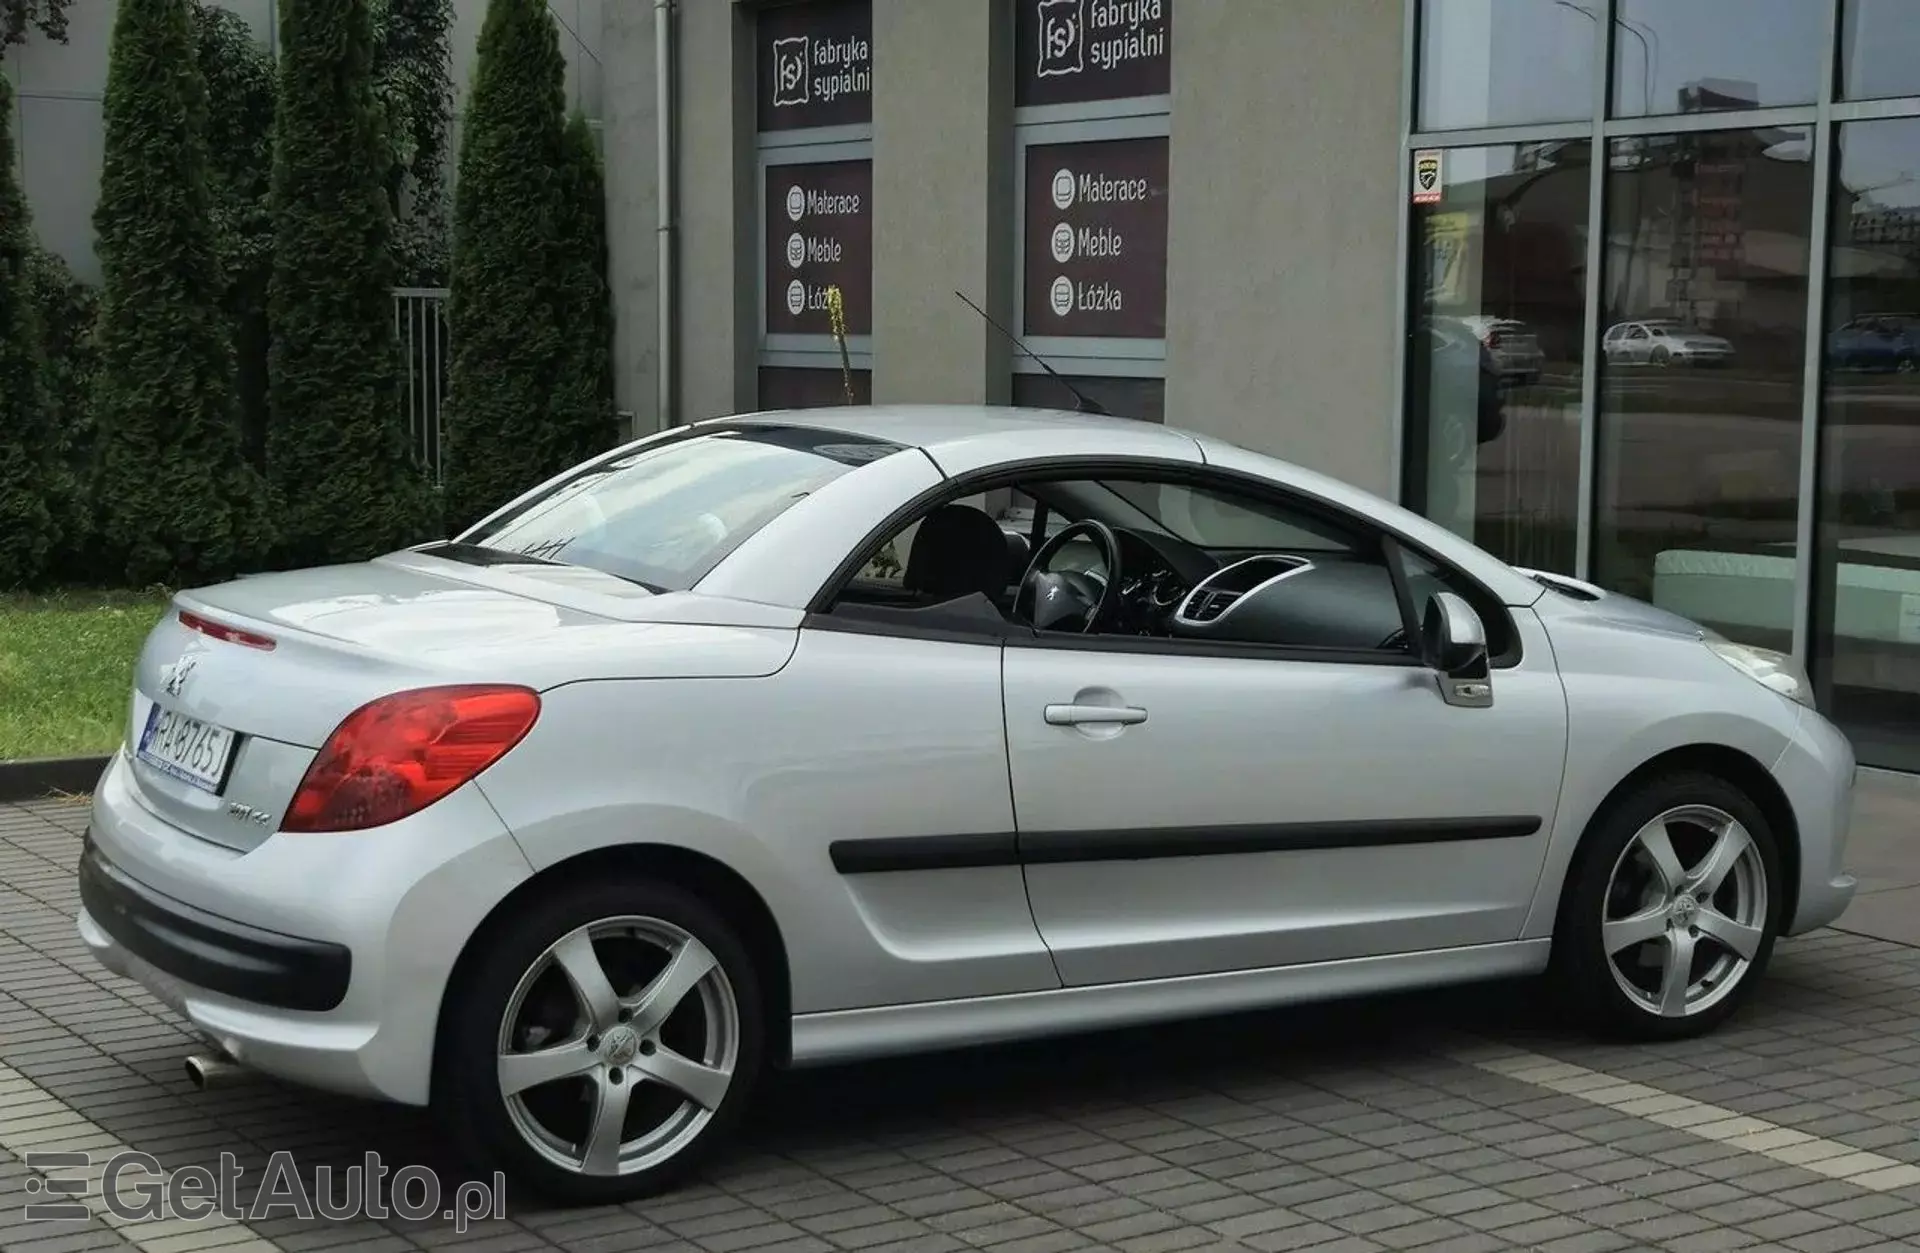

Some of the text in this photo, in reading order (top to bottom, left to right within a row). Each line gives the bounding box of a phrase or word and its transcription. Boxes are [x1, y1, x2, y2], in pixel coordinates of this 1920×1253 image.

[1092, 0, 1161, 30] fabryka
[814, 36, 868, 68] fabryka
[1091, 27, 1164, 70] sypialni
[814, 66, 870, 101] sypialni
[1079, 173, 1147, 202] Materace
[807, 190, 860, 215] Materace
[807, 237, 841, 262] Meble
[1078, 227, 1122, 256] Meble
[808, 284, 841, 310] Łóż
[1078, 281, 1122, 311] Łóżka
